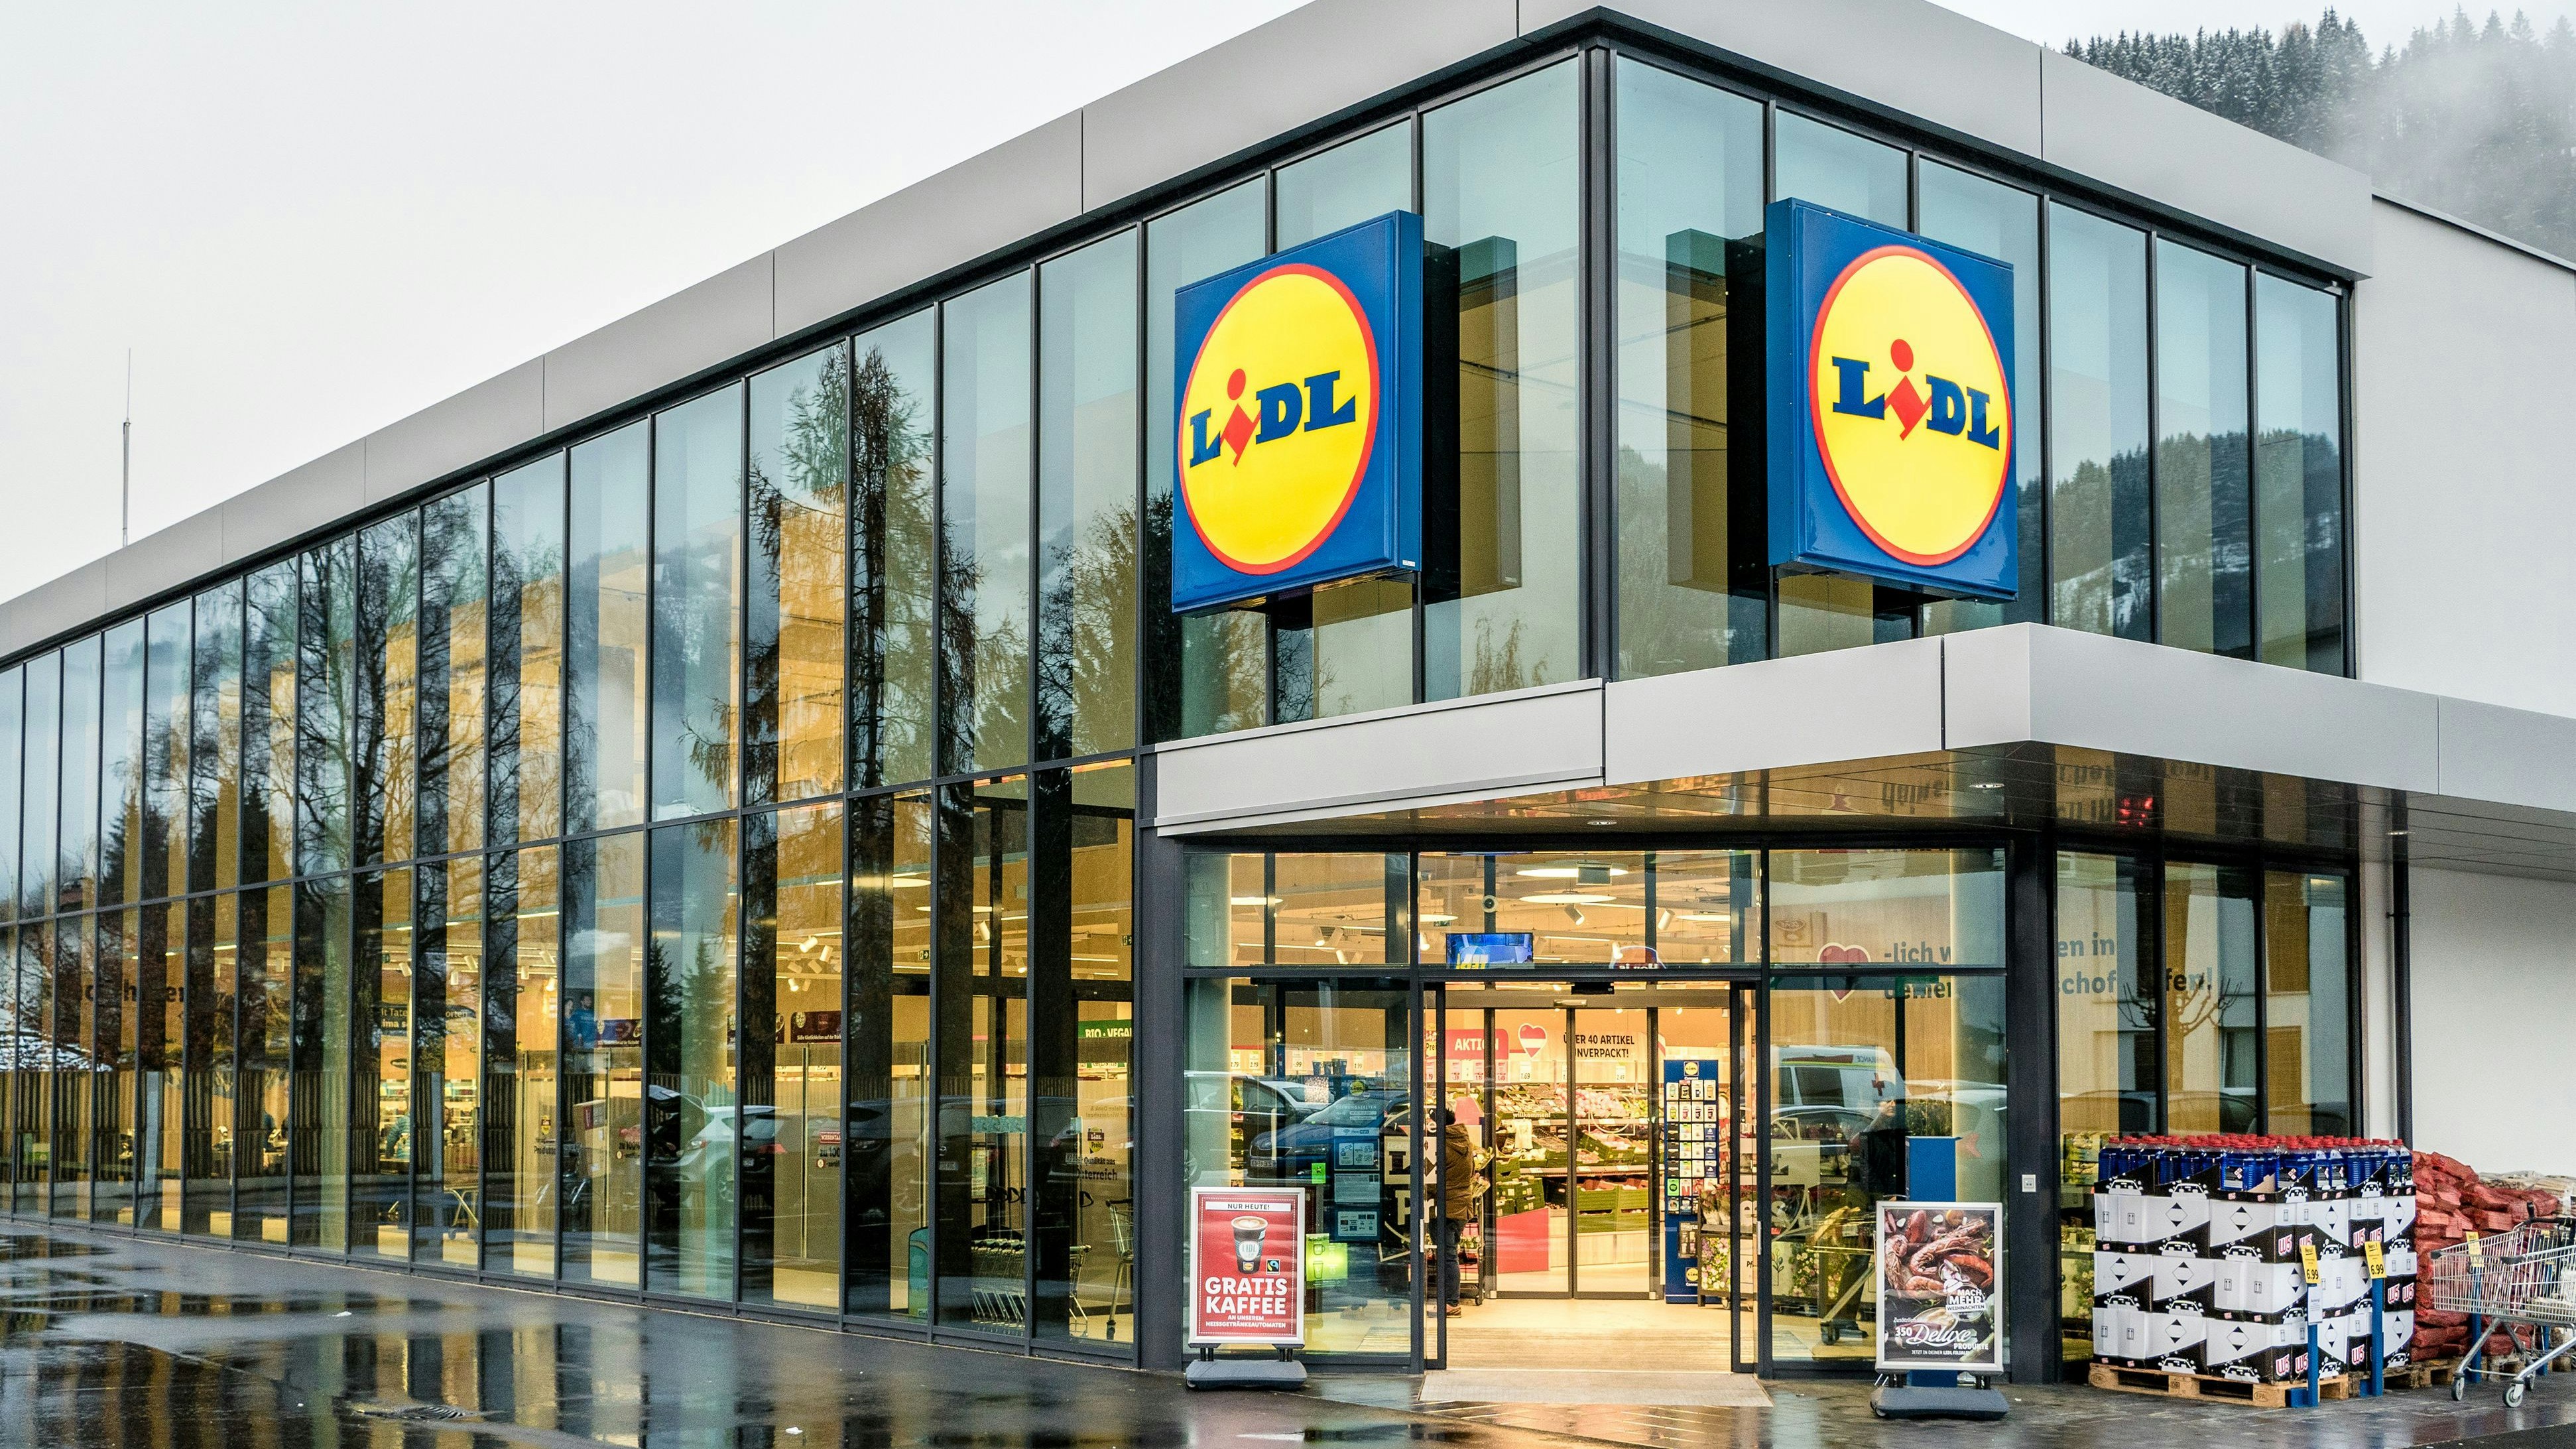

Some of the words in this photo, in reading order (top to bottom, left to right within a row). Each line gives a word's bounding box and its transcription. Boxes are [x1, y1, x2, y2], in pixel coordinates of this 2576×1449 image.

[2092, 932, 2115, 956] in
[1455, 1038, 1499, 1051] AKTI
[1564, 1032, 1585, 1044] ÜER
[1588, 1035, 1598, 1044] 40
[1600, 1035, 1635, 1044] ARTIKEL
[1575, 1048, 1629, 1058] NVERPACKT!
[2278, 1234, 2293, 1255] W5
[2353, 1228, 2366, 1248] W5
[2306, 1269, 2319, 1279] 6.99
[2370, 1264, 2384, 1275] 6.99
[1205, 1277, 1288, 1295] GRATIS
[2388, 1283, 2400, 1304] W5
[2402, 1283, 2415, 1303] W5
[1206, 1296, 1286, 1314] KAFFEE
[1949, 1296, 1982, 1305] MEHR
[1205, 1320, 1286, 1329] HEISSGETRÄNKEAUTOMATEN
[1895, 1327, 1912, 1337] 350
[1906, 1324, 1971, 1347] Deluxe
[2352, 1344, 2364, 1365] W5
[2276, 1354, 2290, 1376] W5
[2295, 1352, 2308, 1373] W5
